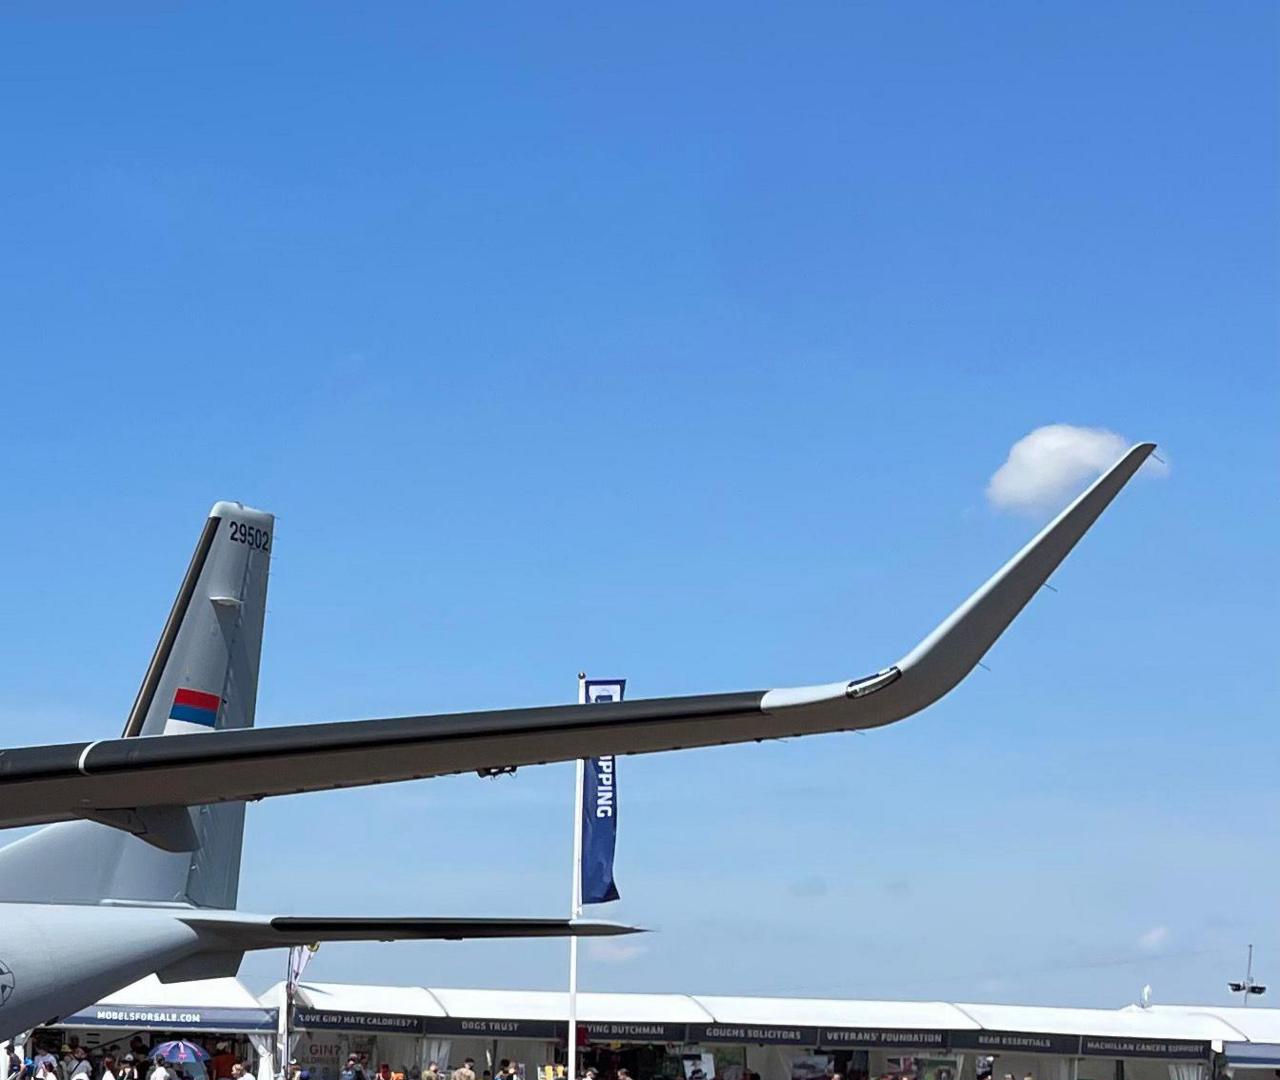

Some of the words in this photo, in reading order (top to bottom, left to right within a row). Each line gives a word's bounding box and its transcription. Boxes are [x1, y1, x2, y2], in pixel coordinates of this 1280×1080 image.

[229, 521, 270, 552] 29502
[596, 755, 613, 818] IPPING
[344, 1016, 366, 1025] HATE
[461, 1021, 486, 1030] DOGS
[489, 1022, 519, 1031] TRUST
[611, 1025, 664, 1035] DUTCHMAN
[747, 1029, 801, 1040] SOLICITORS
[881, 1032, 942, 1043] FOUNDATION
[1135, 1043, 1166, 1052] CANCER
